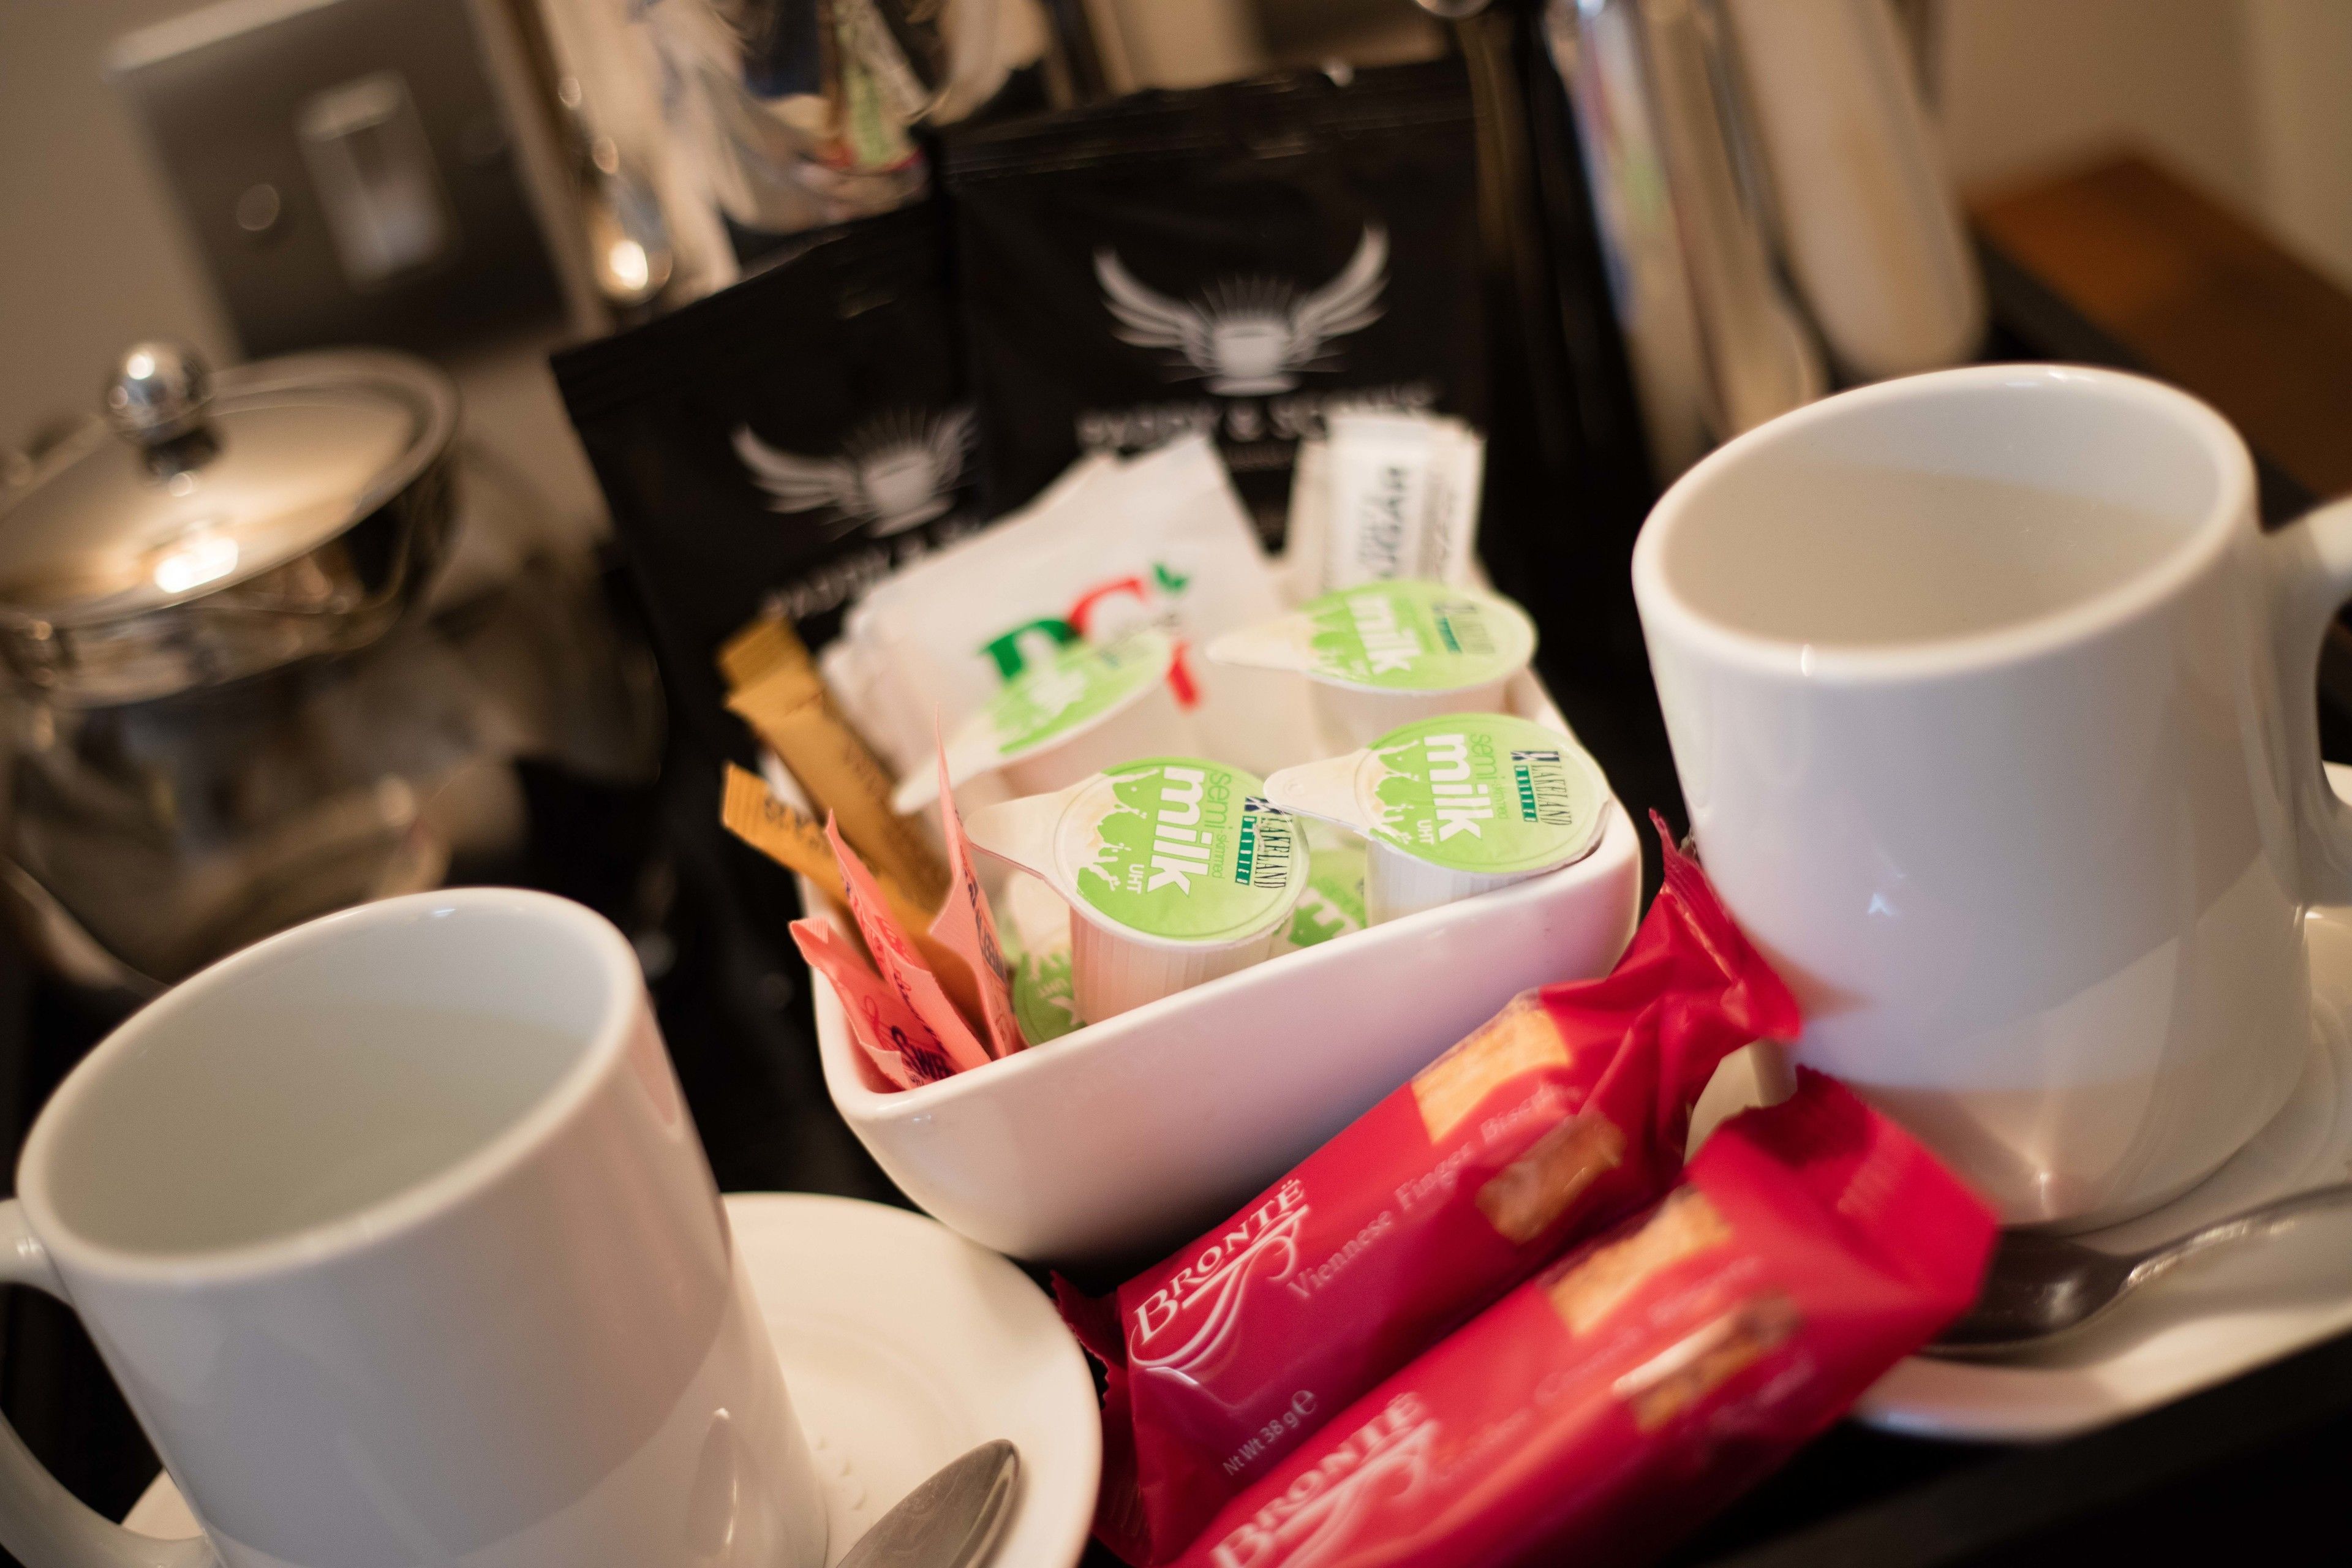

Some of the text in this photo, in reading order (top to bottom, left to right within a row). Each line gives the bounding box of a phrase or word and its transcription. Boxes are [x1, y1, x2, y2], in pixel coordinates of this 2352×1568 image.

[1423, 733, 1494, 842] milk
[1531, 764, 1572, 826] LAKELAND
[1147, 766, 1213, 896] milk
[1254, 817, 1293, 889] LAKELAND
[1416, 819, 1434, 845] UHT
[1126, 864, 1145, 894] UHT
[1287, 1210, 1393, 1299] Viennese
[1395, 1141, 1472, 1211] Finger
[1133, 1178, 1305, 1344] BRONTË
[1223, 1455, 1243, 1476] Nt
[1238, 1436, 1265, 1461] Wt
[1260, 1419, 1285, 1444] 38
